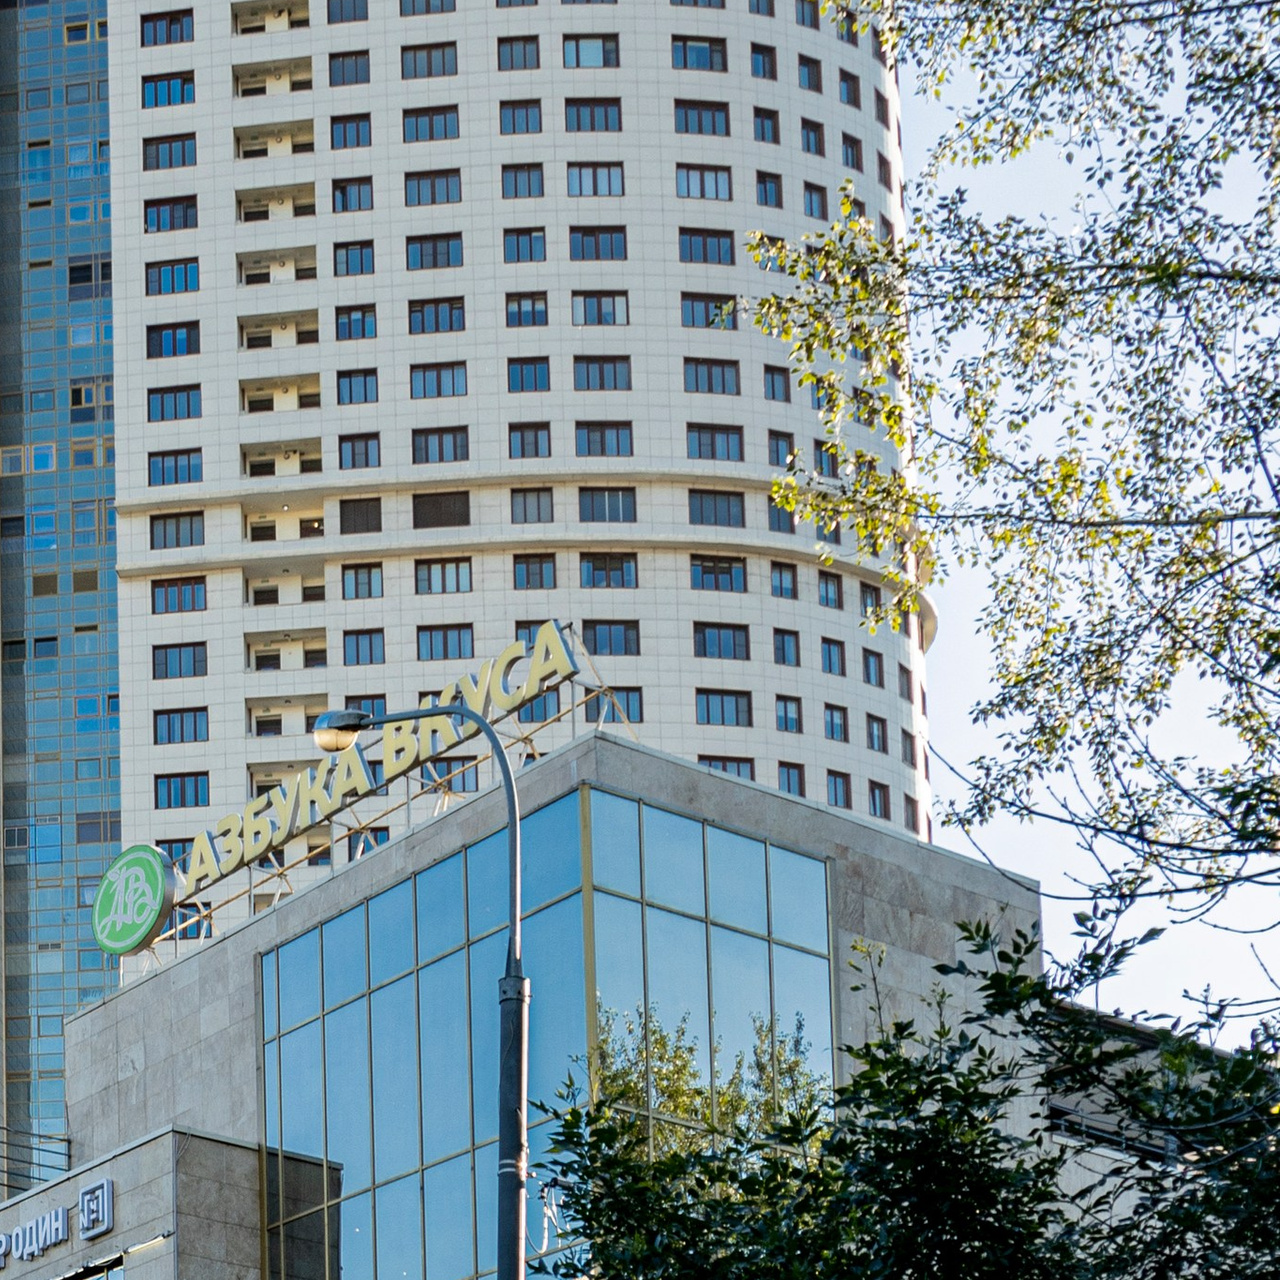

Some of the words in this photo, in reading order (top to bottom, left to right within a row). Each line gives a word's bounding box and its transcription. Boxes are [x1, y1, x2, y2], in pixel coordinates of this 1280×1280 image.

[184, 743, 376, 896] АЗБУКА
[382, 619, 580, 782] ВКУСА
[11, 1206, 68, 1261] ОДИН
